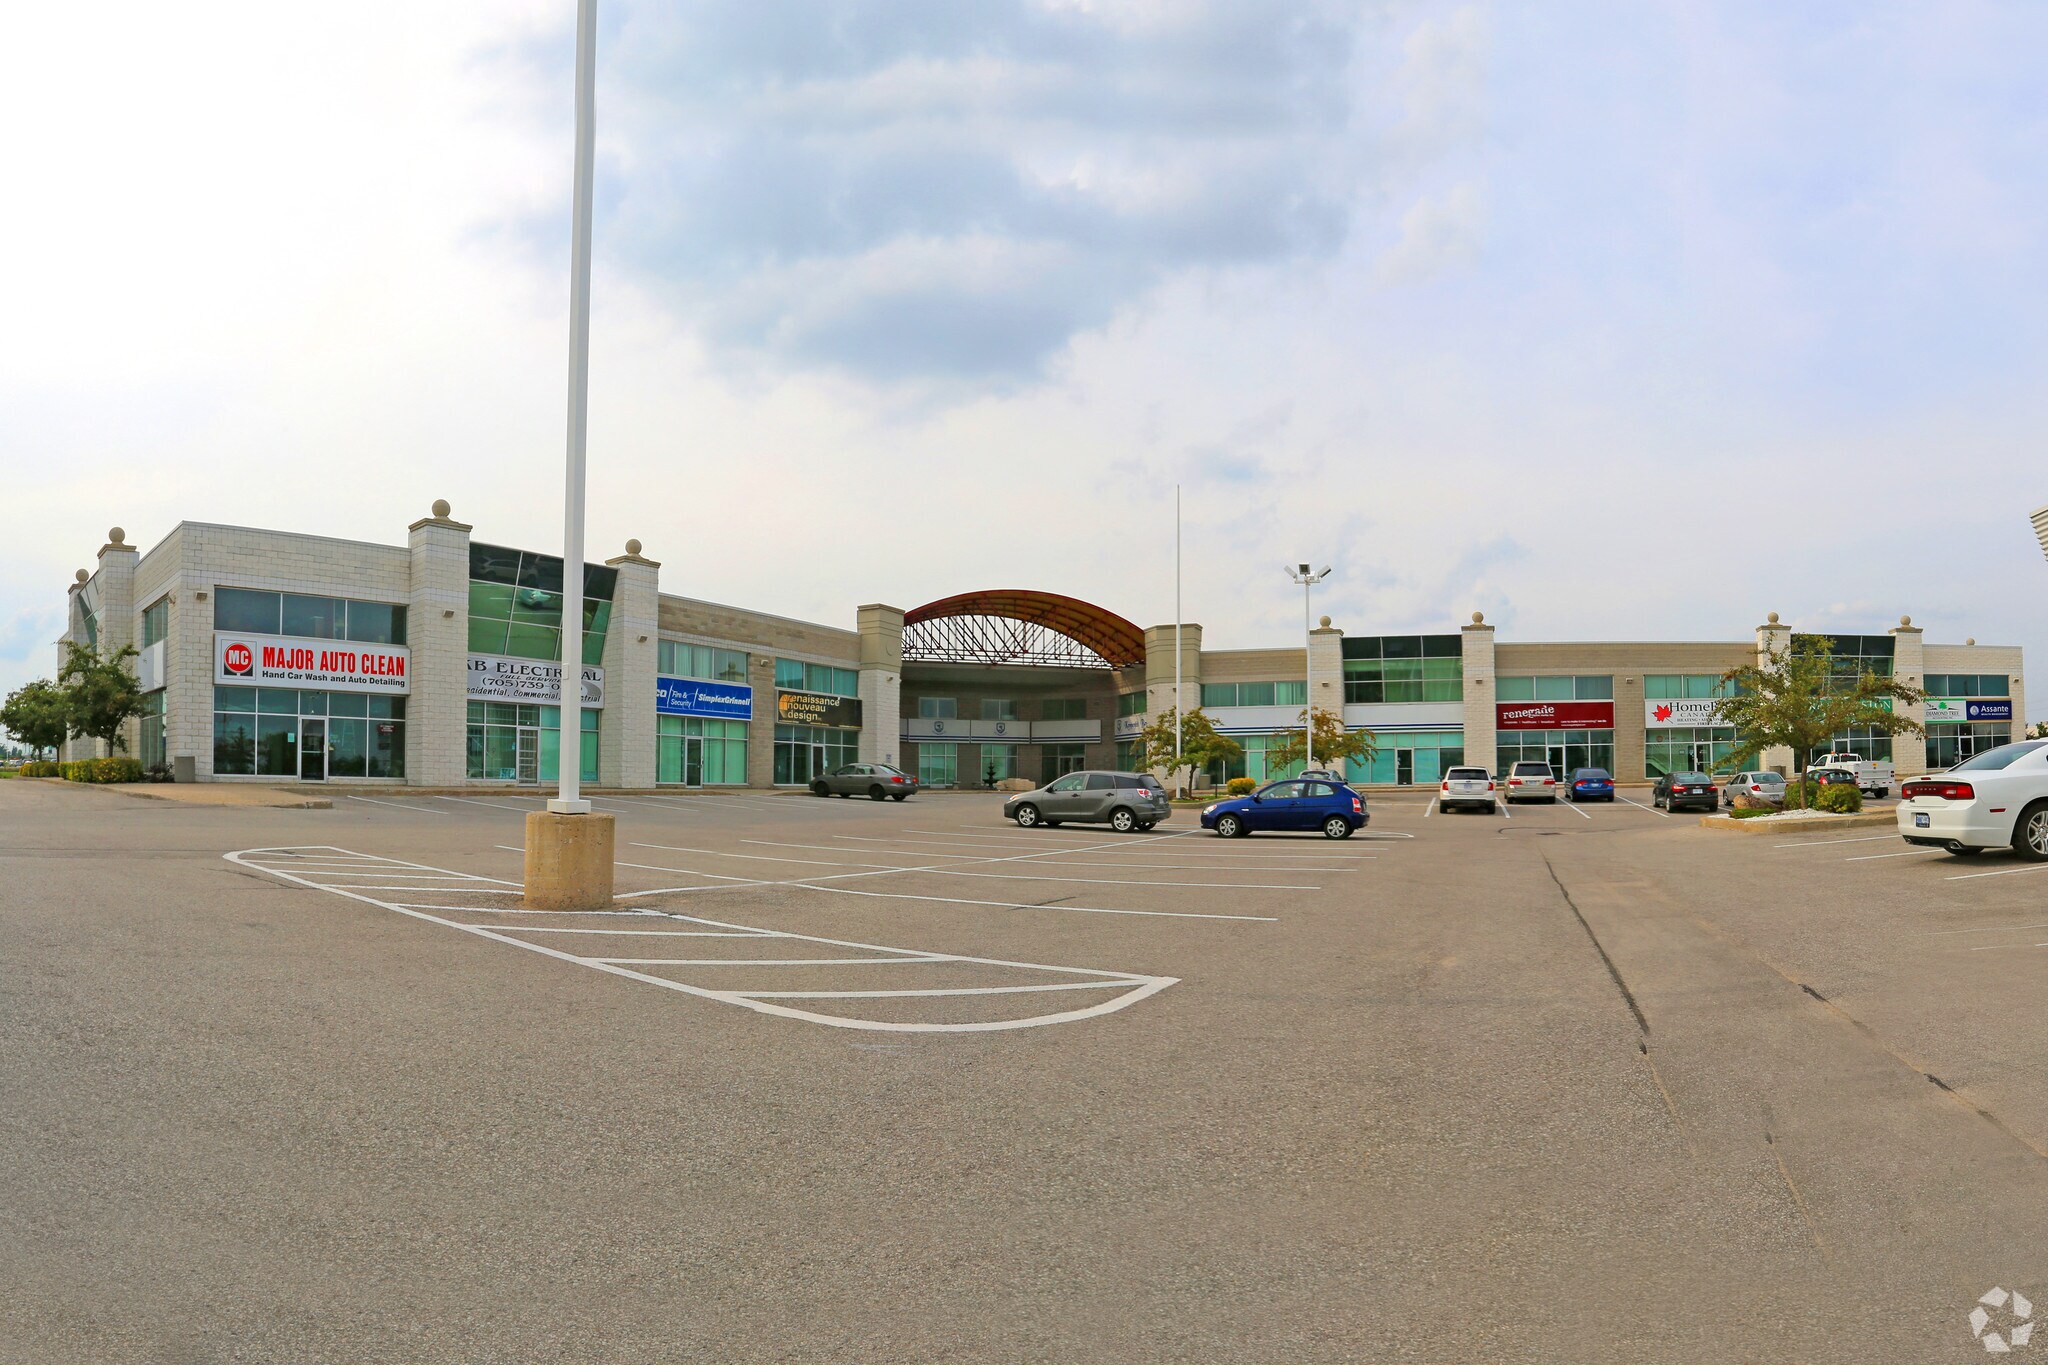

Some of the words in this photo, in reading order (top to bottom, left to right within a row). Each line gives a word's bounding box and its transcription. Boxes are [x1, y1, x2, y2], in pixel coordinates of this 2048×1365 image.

[229, 650, 249, 665] MC
[263, 646, 314, 670] MAJOR
[319, 650, 356, 673] AUTO
[361, 653, 405, 677] CLEAN
[496, 662, 602, 681] ELECTRAL
[262, 670, 285, 679] Hand
[287, 672, 302, 680] Car
[305, 673, 328, 682] Wash
[330, 674, 346, 683] and
[348, 675, 367, 684] Auto
[369, 677, 405, 688] Detailing
[482, 677, 560, 691] (705)739-0
[672, 690, 682, 698] Fire
[698, 693, 751, 706] SimplexGrinnell
[670, 699, 693, 708] Security
[787, 702, 826, 712] nouveau
[1980, 705, 2009, 713] Assante
[1502, 705, 1555, 719] renegade
